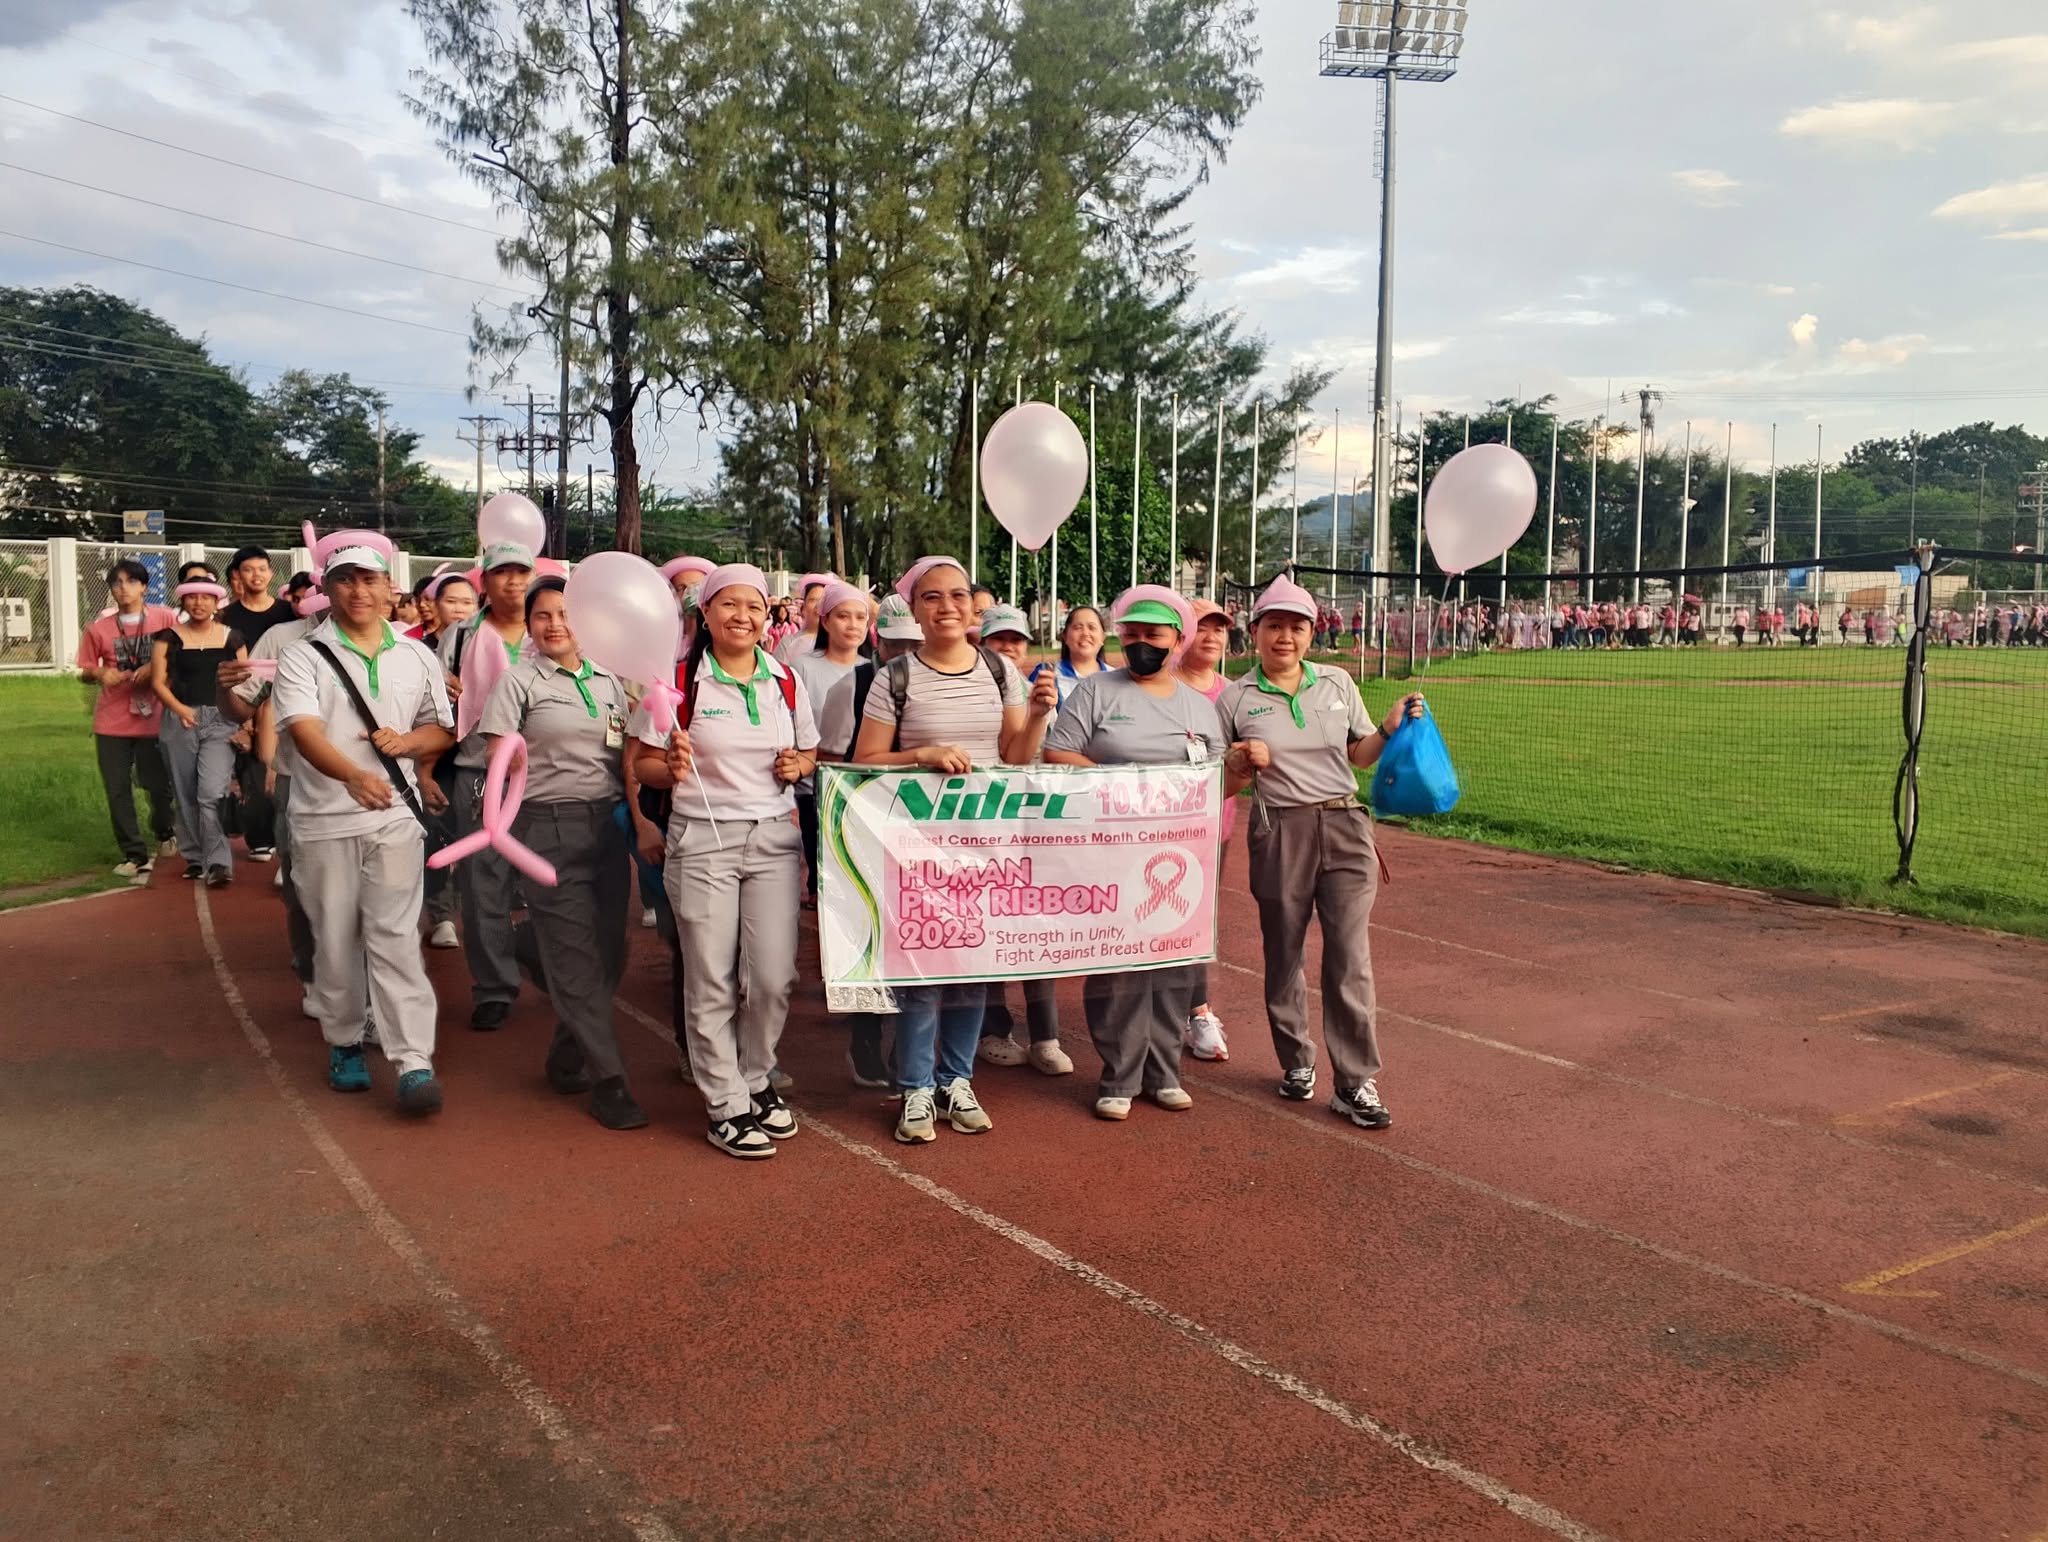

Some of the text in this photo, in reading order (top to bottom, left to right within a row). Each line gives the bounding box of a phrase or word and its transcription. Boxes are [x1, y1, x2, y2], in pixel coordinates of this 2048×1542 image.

[887, 777, 1089, 820] Nidec
[948, 834, 1002, 846] Cancer
[1010, 833, 1087, 845] Awareness
[1091, 832, 1133, 844] Month
[1138, 827, 1207, 842] Celebration
[899, 857, 1032, 888] HUMAN
[899, 884, 1118, 919] PINK RIBBON
[899, 918, 986, 950] 2025
[1070, 929, 1083, 942] in
[1089, 926, 1126, 942] Unity,
[995, 948, 1034, 965] Fight
[1039, 945, 1095, 964] Against
[1101, 941, 1144, 957] Breast
